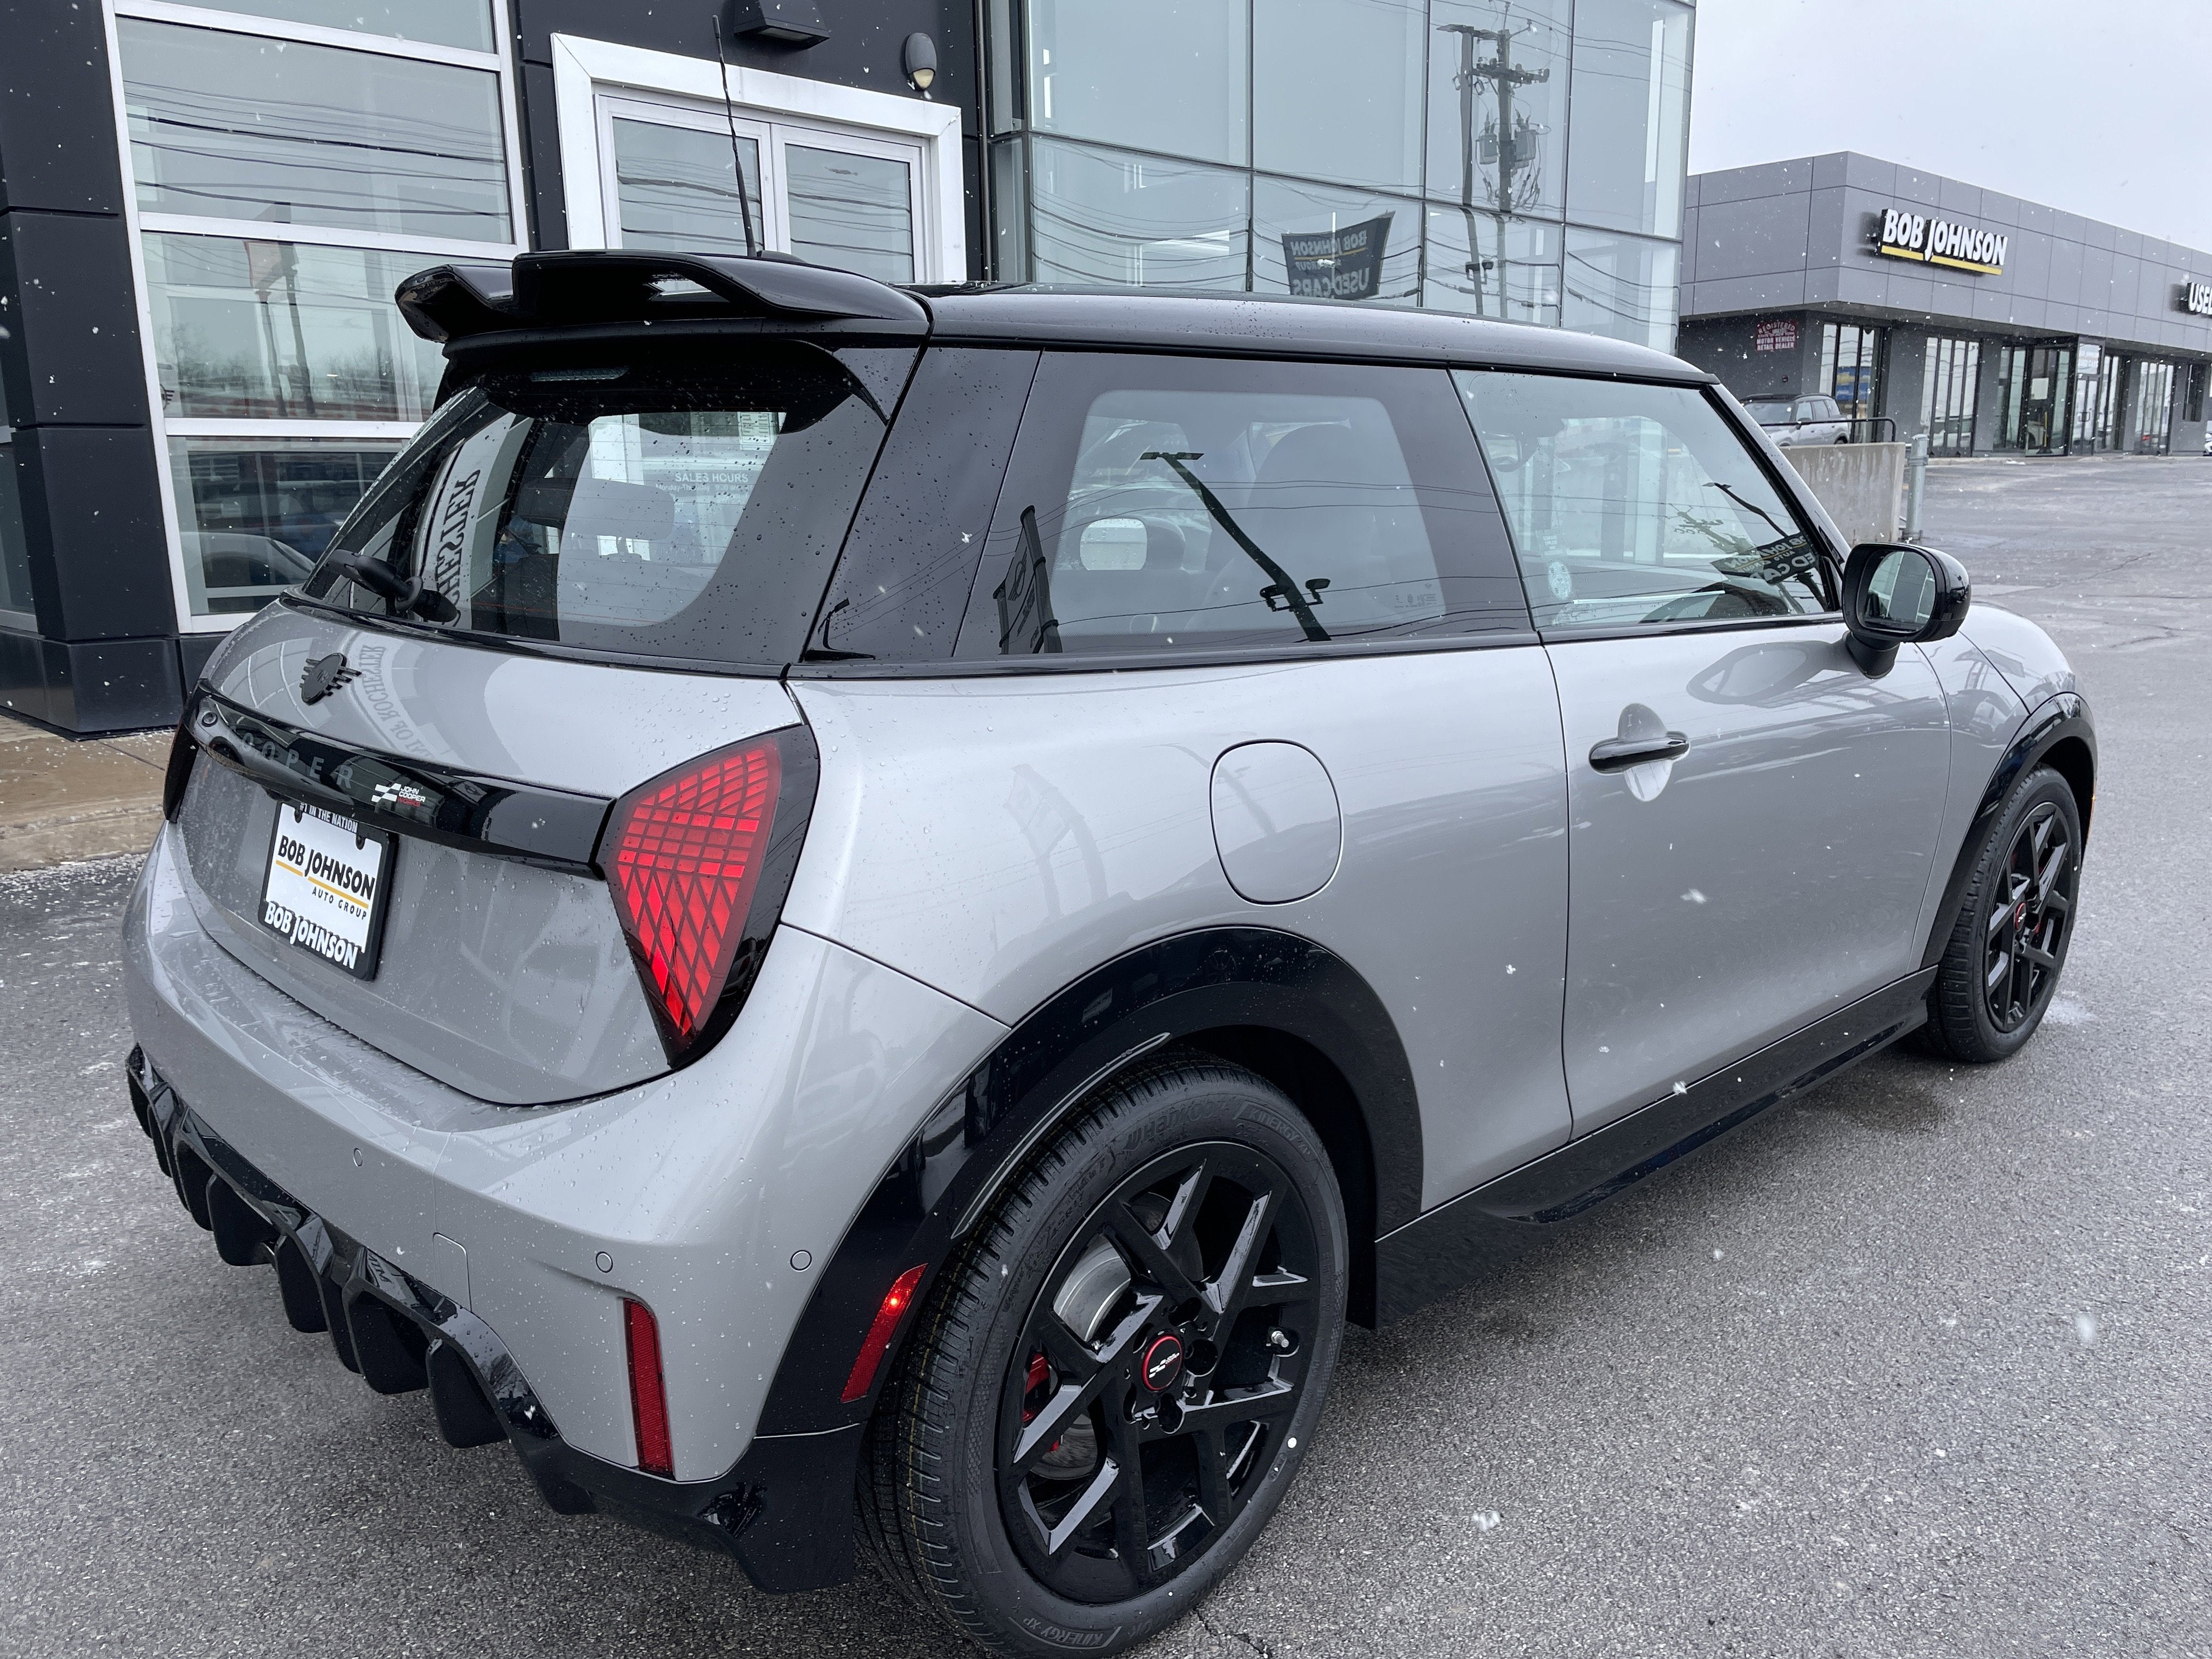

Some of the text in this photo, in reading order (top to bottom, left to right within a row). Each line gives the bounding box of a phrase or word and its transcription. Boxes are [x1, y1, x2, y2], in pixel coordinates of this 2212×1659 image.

[1883, 208, 2008, 266] BOB JOHNSON
[675, 472, 749, 483] SALES HOURS
[398, 791, 426, 803] COOPER
[400, 786, 420, 795] JOHN
[309, 804, 317, 817] IN
[318, 808, 331, 822] THE
[331, 812, 358, 833] NATION
[278, 834, 375, 901] BOB JOHNSON
[311, 886, 367, 921] AUTO GROUP
[264, 902, 358, 970] BOB JOHNSON
[1040, 1625, 1103, 1646] KINERGY
